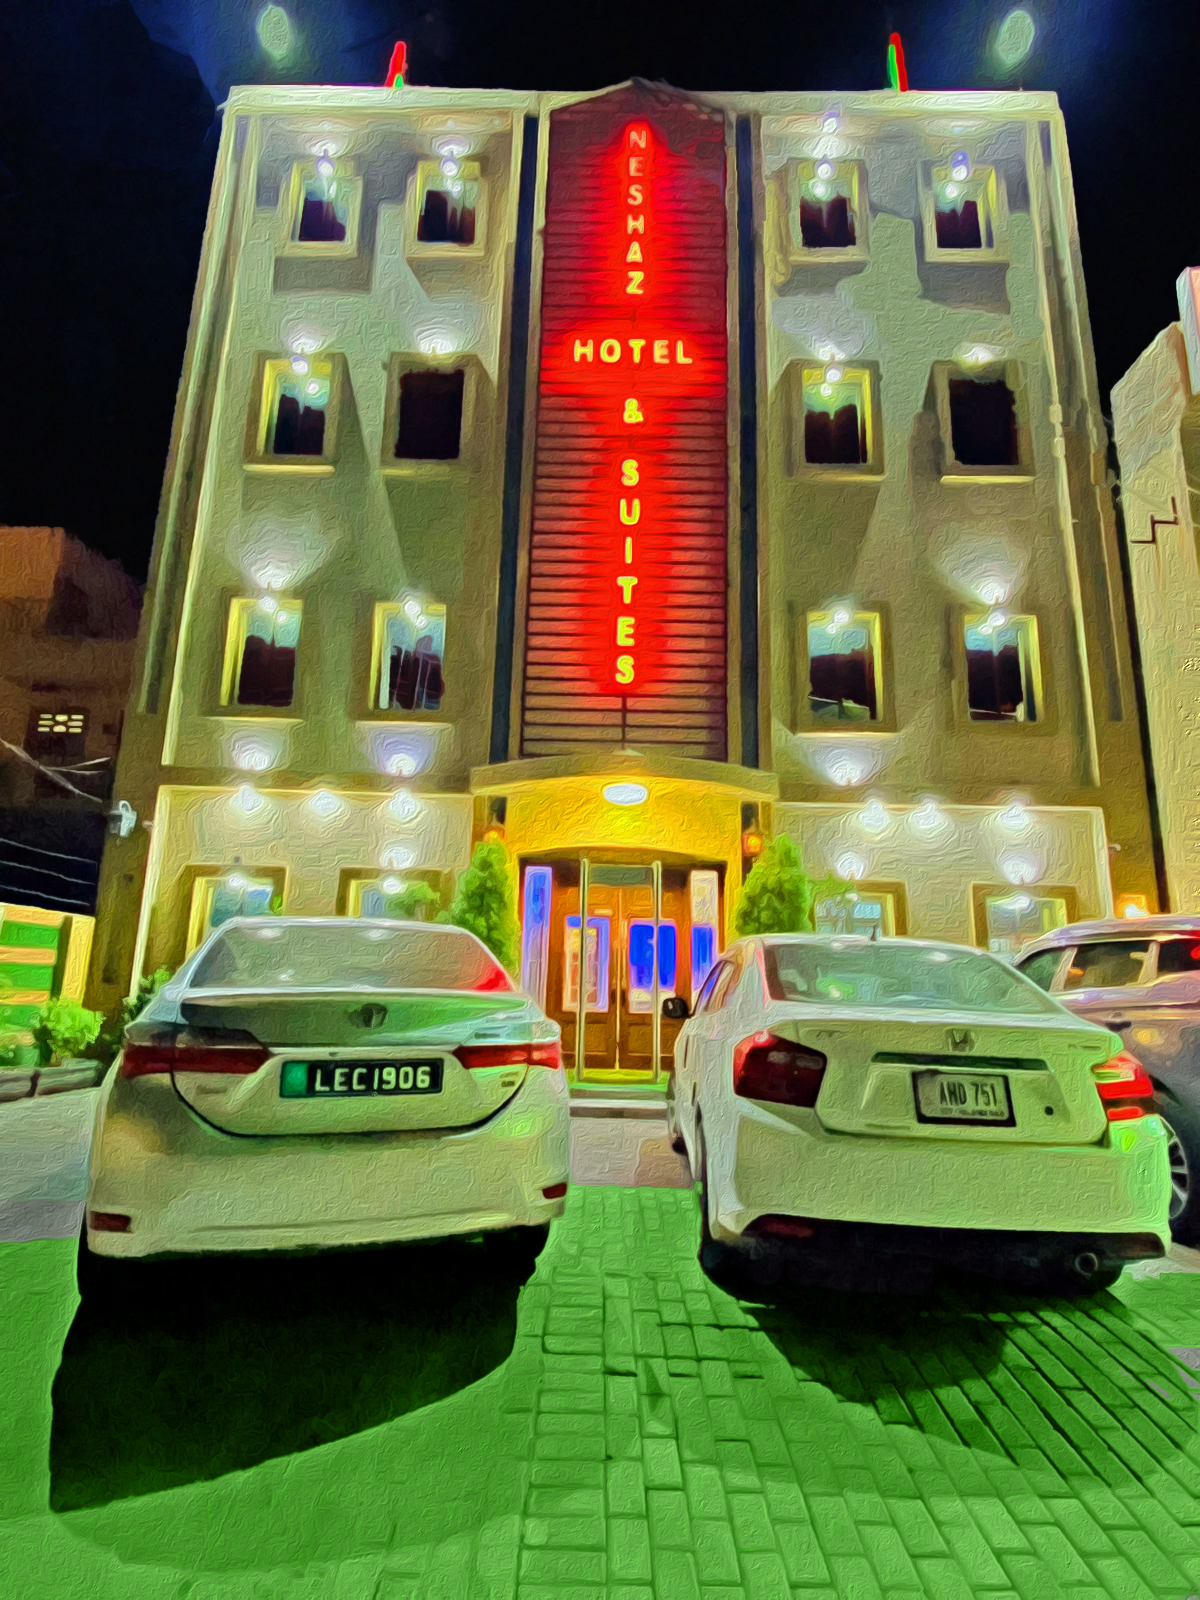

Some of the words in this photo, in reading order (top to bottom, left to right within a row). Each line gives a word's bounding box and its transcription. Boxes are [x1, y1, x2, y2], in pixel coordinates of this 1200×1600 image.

[626, 130, 648, 296] NESHAZ
[573, 339, 693, 365] HOTEL
[623, 397, 644, 423] &
[615, 459, 641, 684] SUITES
